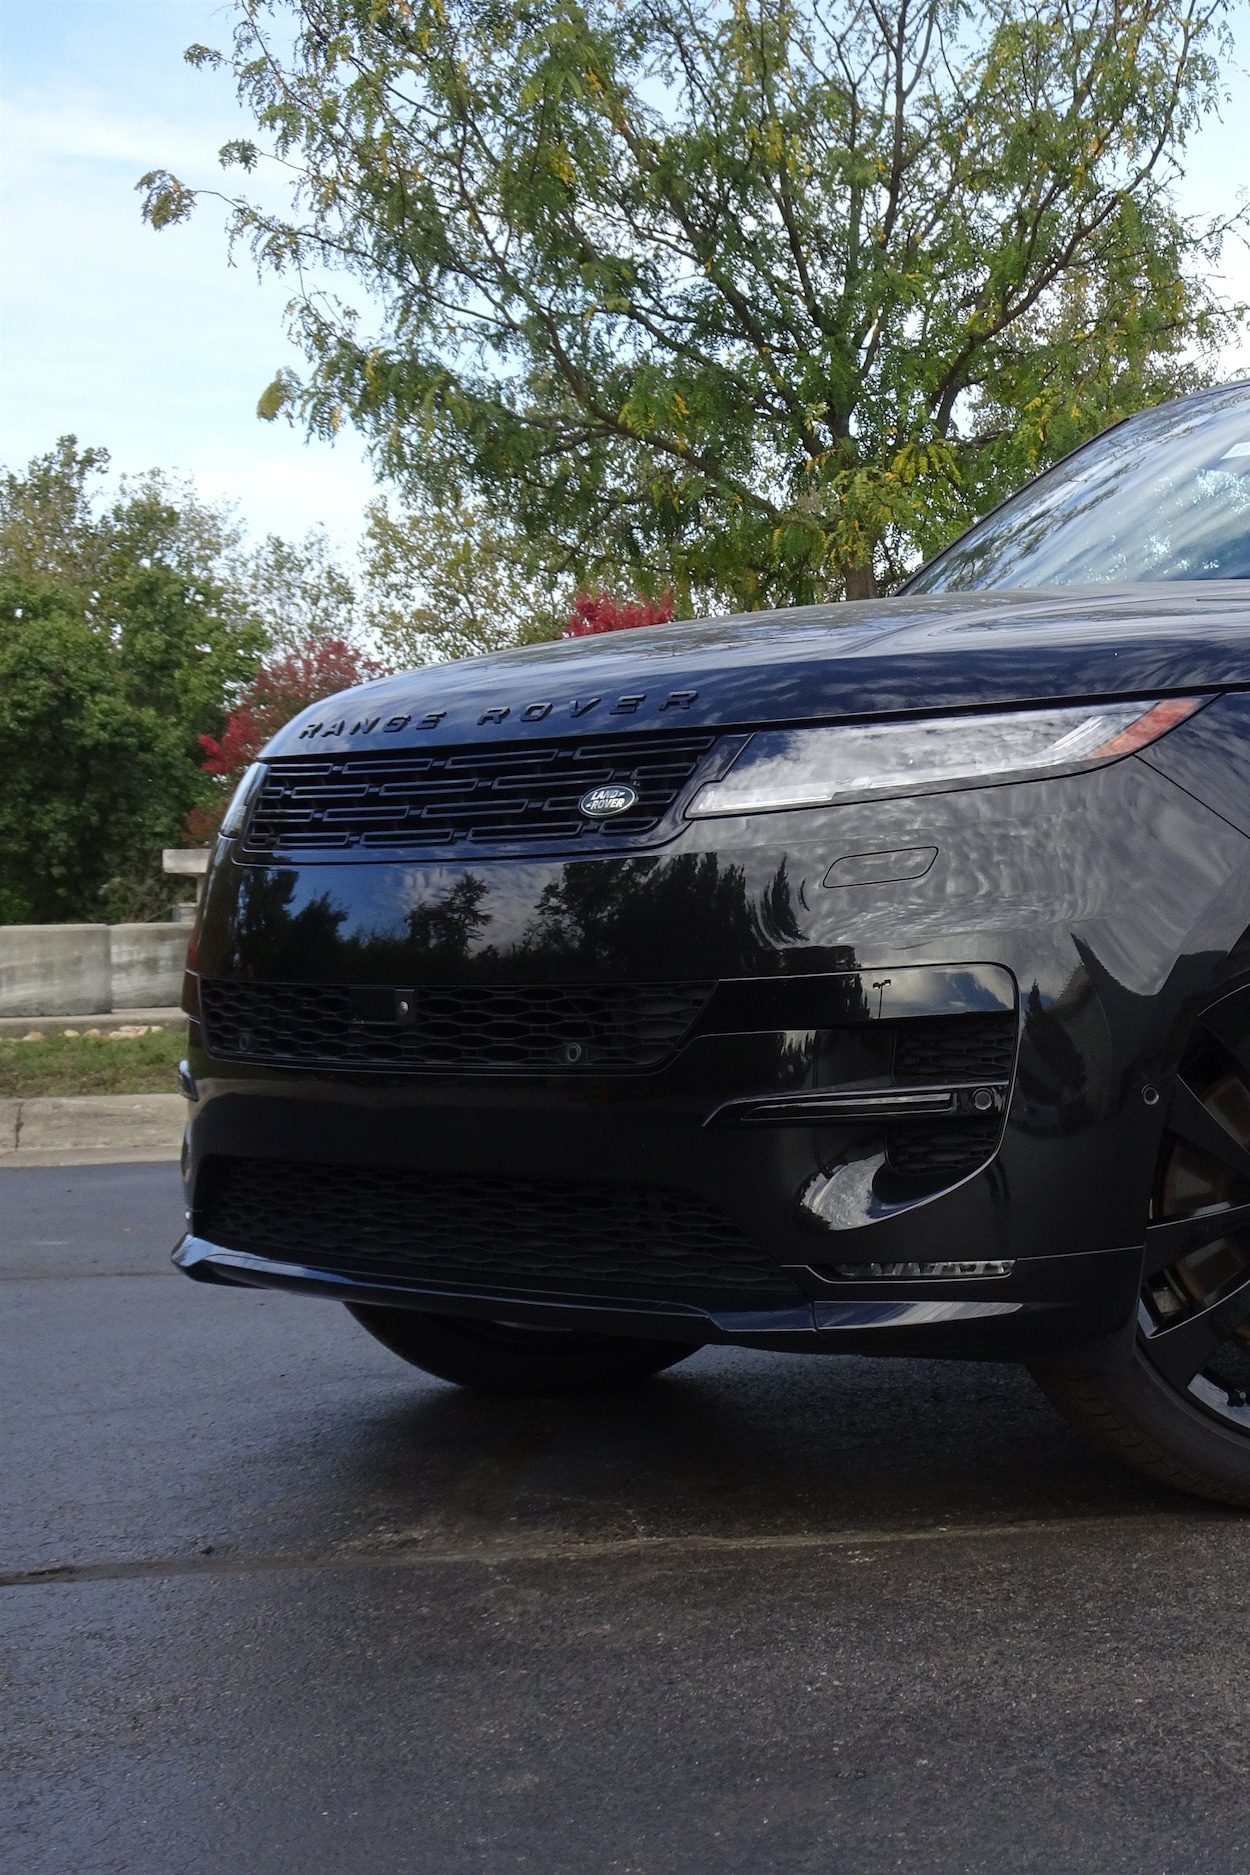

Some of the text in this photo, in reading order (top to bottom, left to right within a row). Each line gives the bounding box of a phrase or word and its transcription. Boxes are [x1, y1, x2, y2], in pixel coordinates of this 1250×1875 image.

[297, 689, 700, 740] RANGE ROVER
[590, 789, 619, 801] LAND
[590, 798, 626, 810] ROVER
